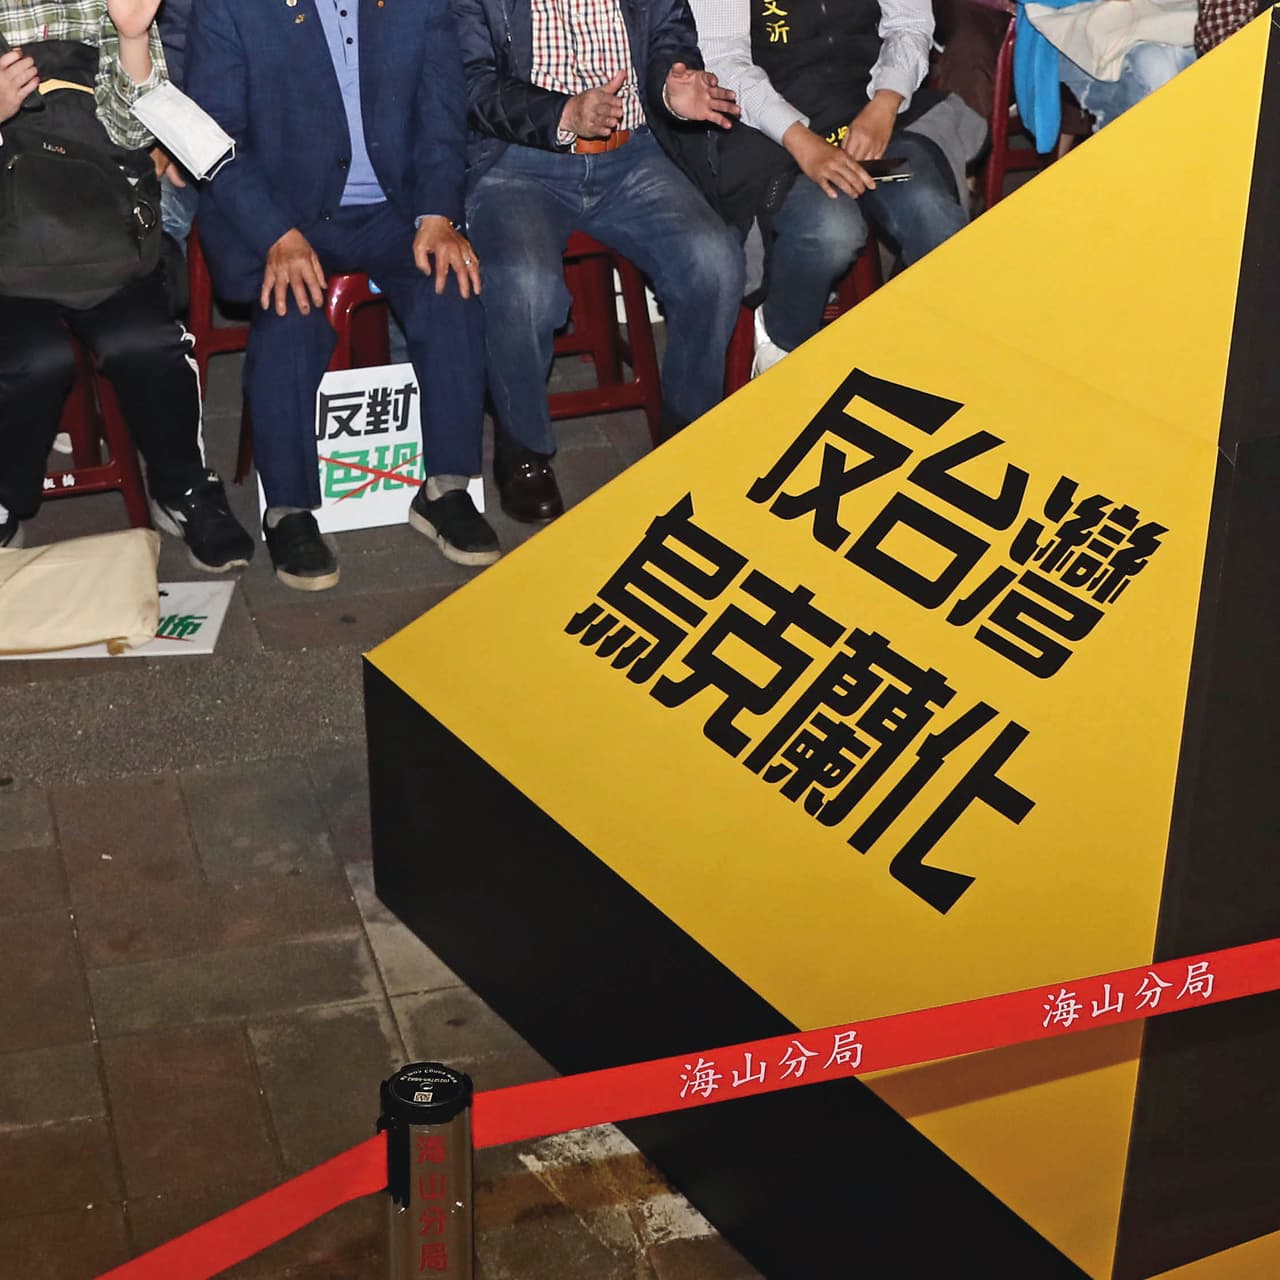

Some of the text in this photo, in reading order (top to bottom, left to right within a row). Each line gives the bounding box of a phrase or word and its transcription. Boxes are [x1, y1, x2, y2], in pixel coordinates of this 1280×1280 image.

[317, 382, 418, 440] 反對
[319, 441, 425, 498] 色恐
[745, 367, 1170, 680] 反台灣
[563, 491, 1036, 916] 烏克蘭化
[1041, 960, 1216, 1028] 海山分局
[678, 1029, 865, 1099] 海山分局
[416, 1135, 449, 1273] 海山分局
